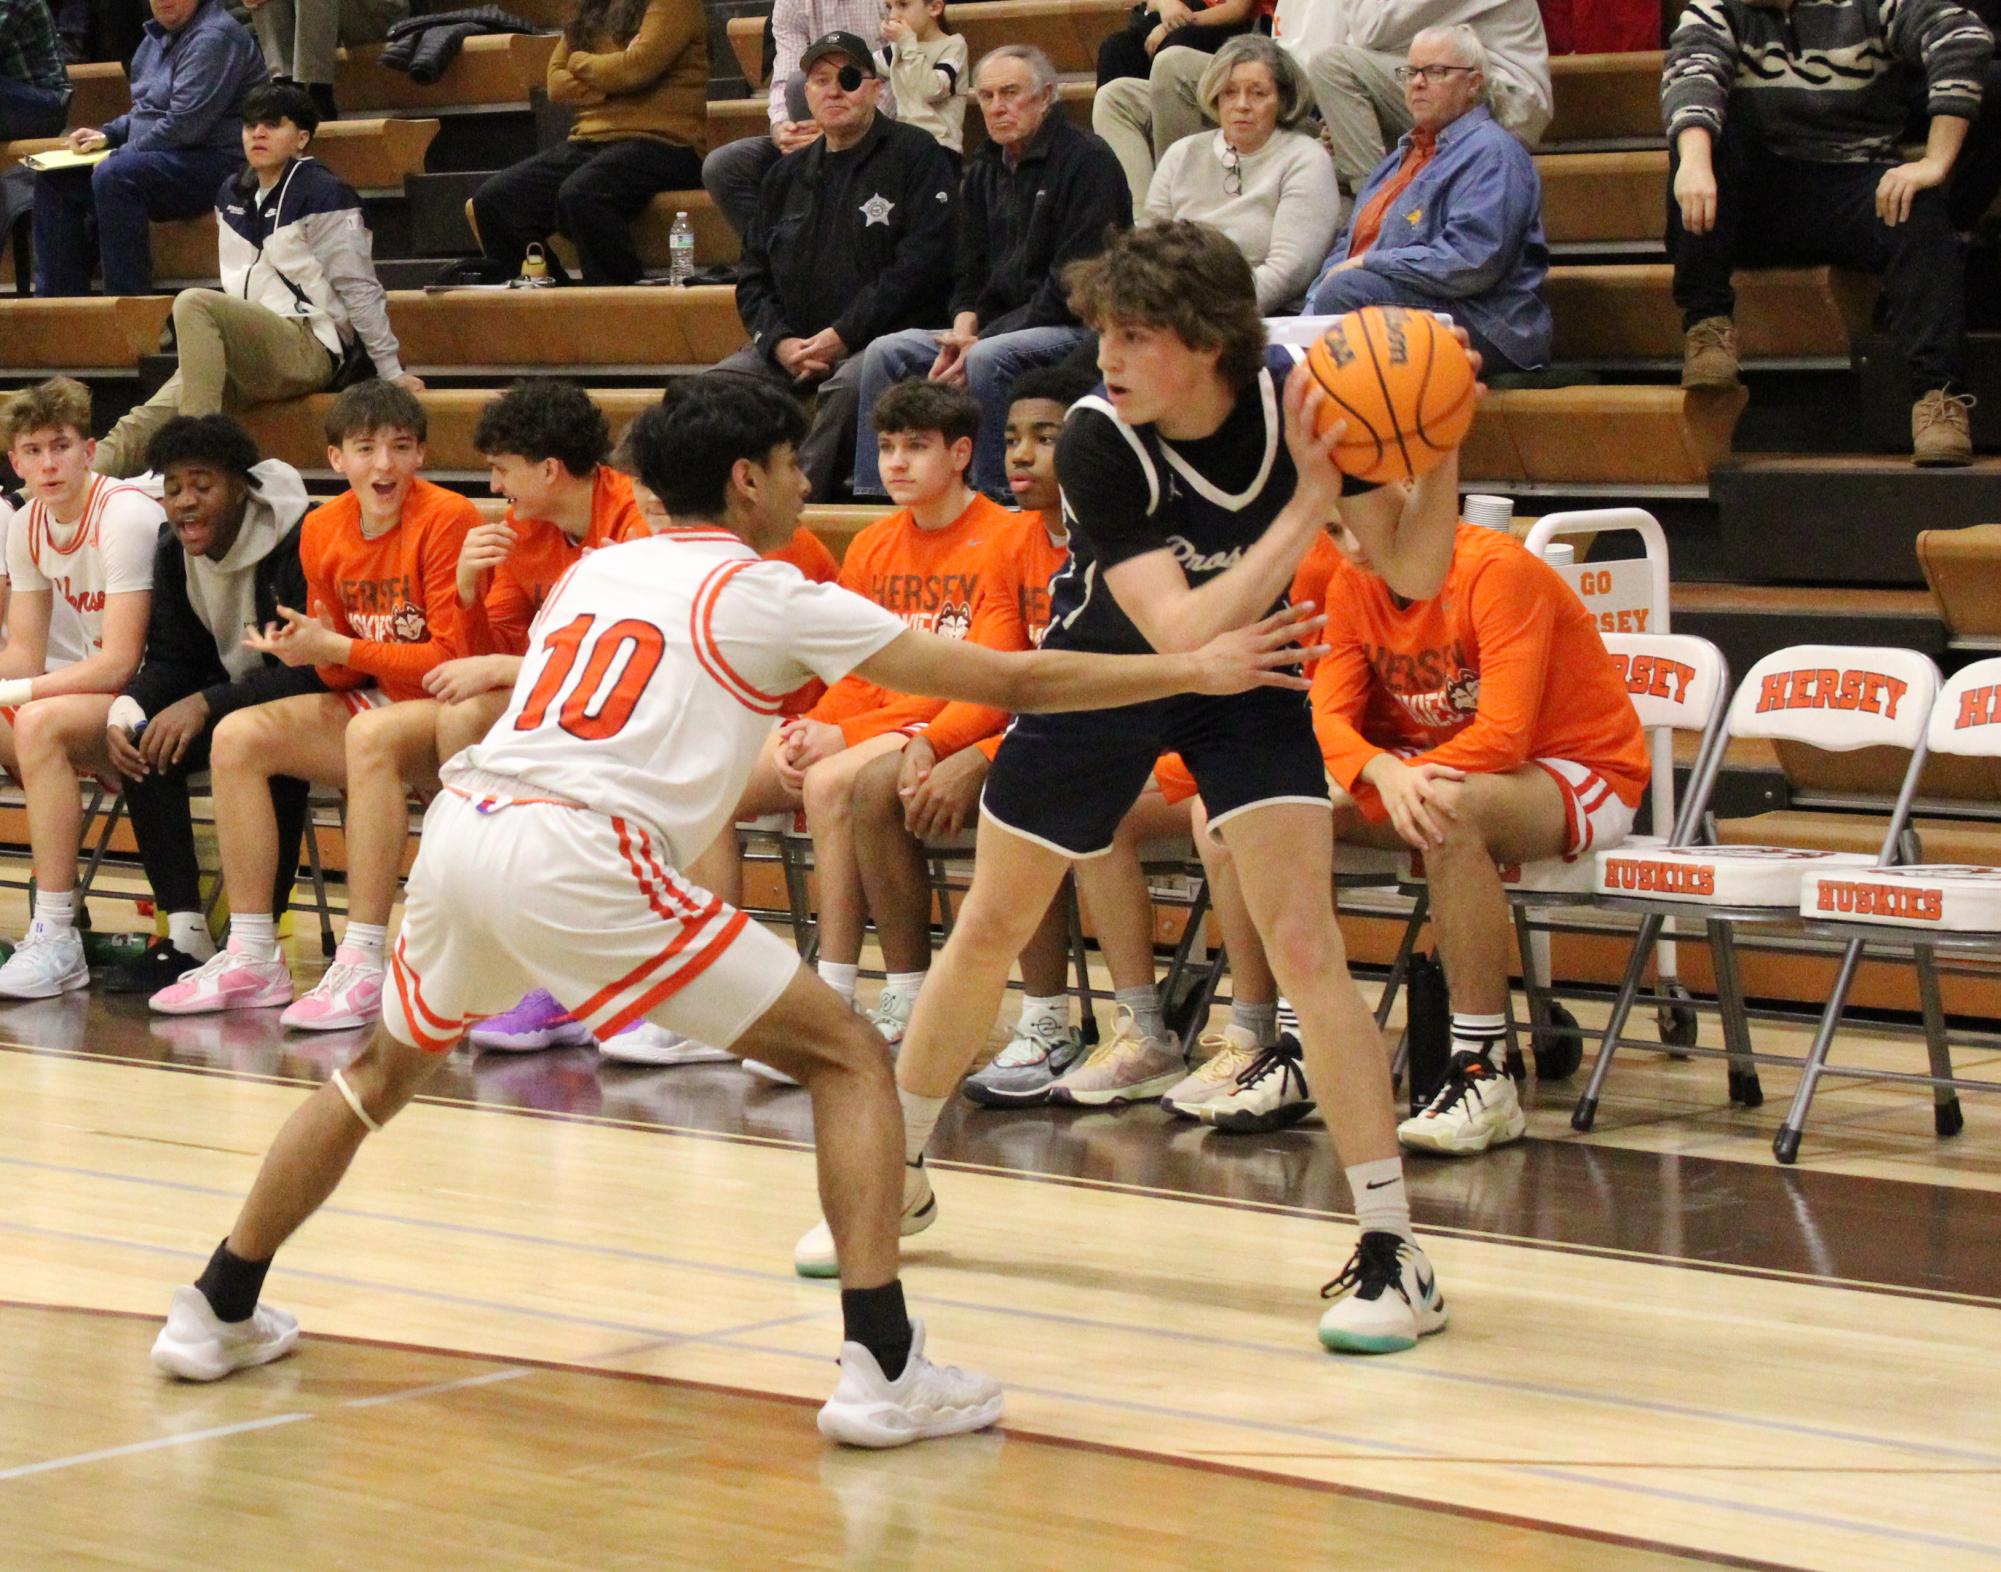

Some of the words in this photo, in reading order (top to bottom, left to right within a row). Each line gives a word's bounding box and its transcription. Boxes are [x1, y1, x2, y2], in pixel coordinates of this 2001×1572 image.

[1581, 571, 1611, 596] GO
[512, 613, 666, 741] 10
[1755, 668, 1908, 720] HERSEY
[1604, 857, 1716, 896] HUSKIES
[1816, 879, 1944, 921] HUSKIES
